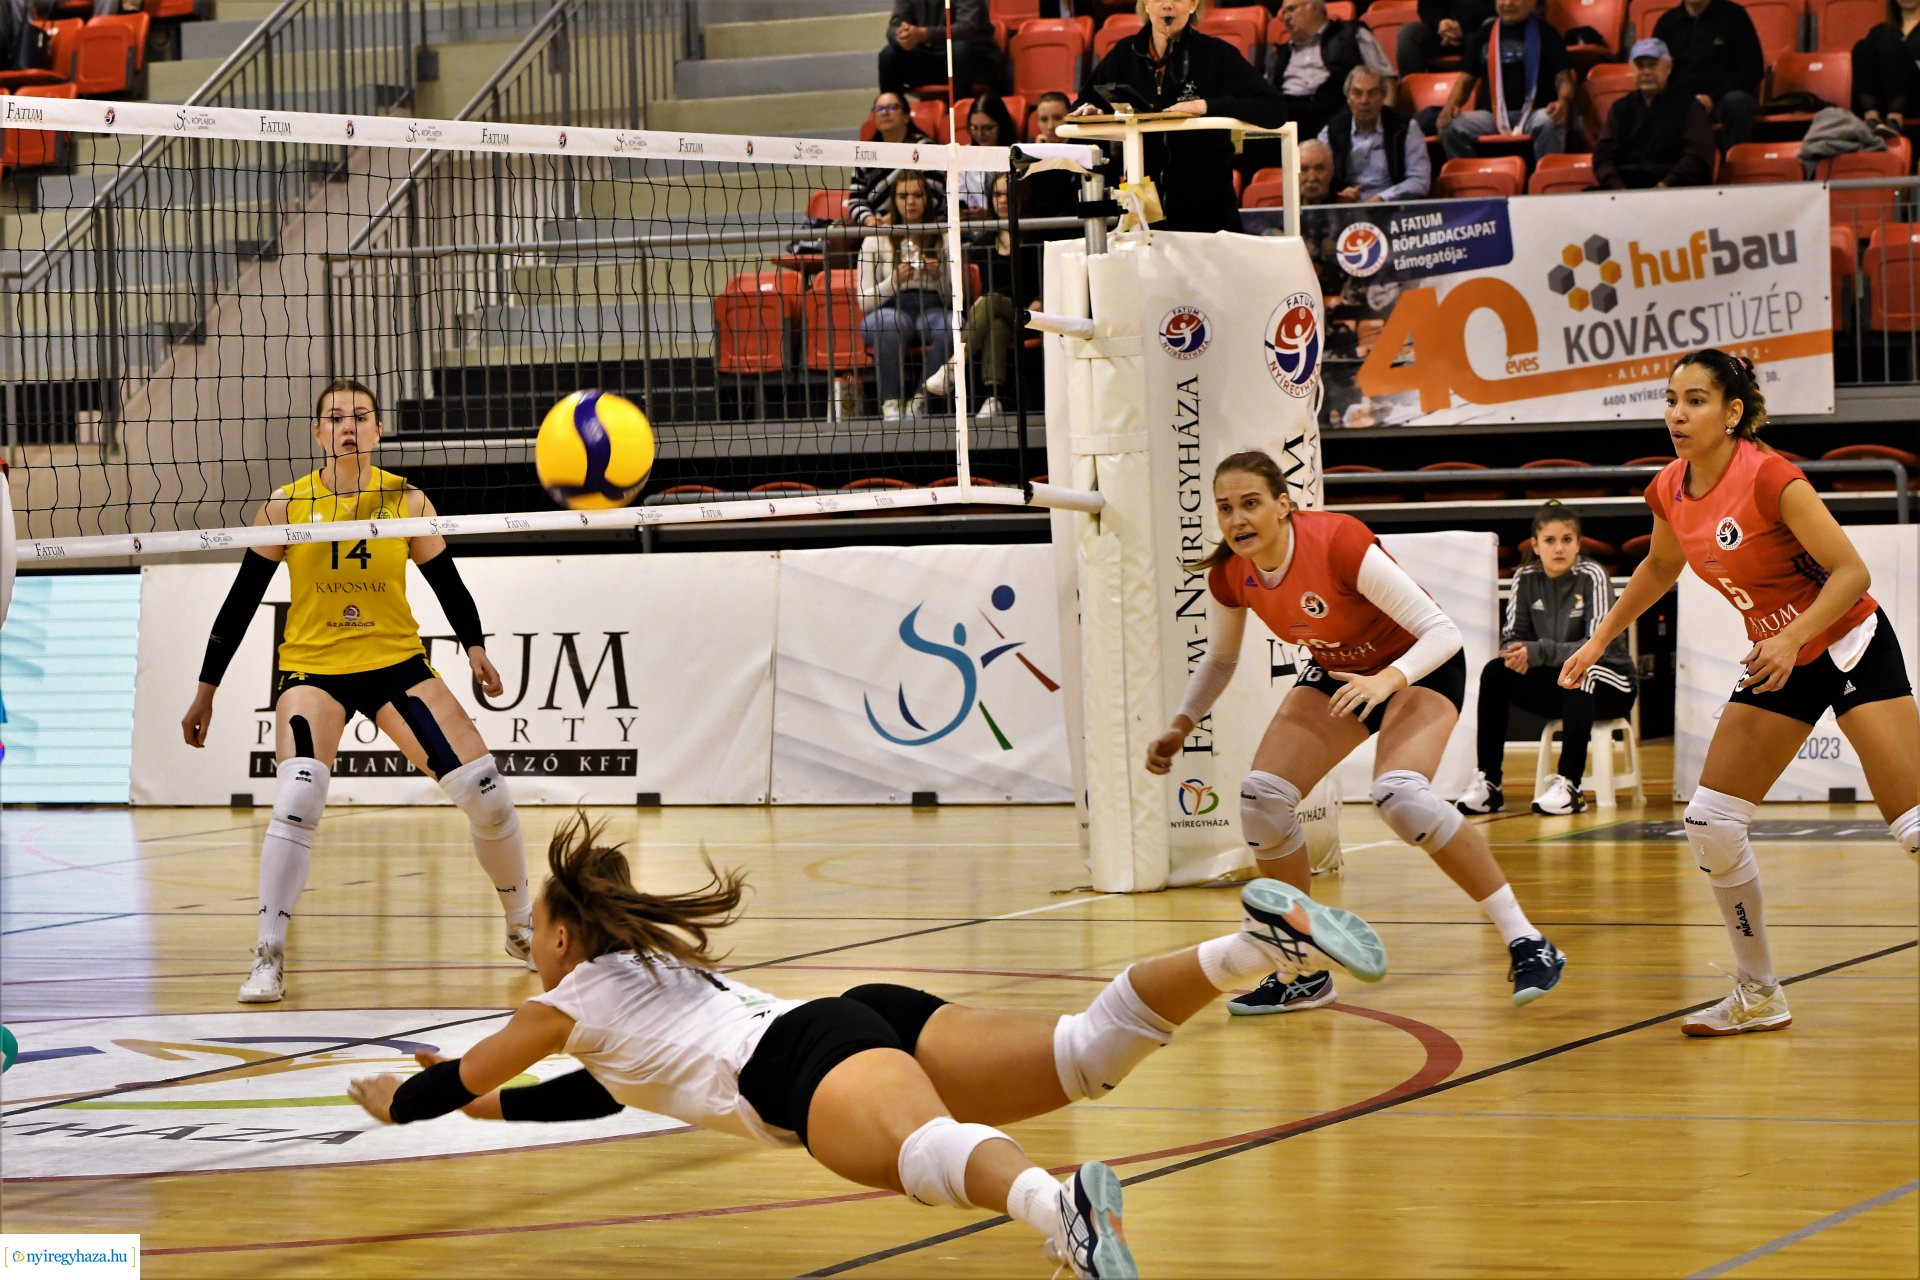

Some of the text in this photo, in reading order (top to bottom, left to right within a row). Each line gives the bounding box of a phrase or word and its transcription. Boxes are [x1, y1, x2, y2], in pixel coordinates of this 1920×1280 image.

[6, 102, 43, 120] FATUM
[260, 116, 291, 133] FATUM
[481, 128, 509, 145] FATUM
[679, 137, 704, 153] FATUM
[1390, 212, 1442, 234] A FATUM
[1392, 220, 1497, 252] RÖPLABDACSAPAT
[1394, 246, 1468, 270] támogatója:
[1628, 228, 1798, 288] hufbau
[1172, 307, 1200, 316] FATUM
[1564, 282, 1803, 365] KOVÁCSTÜZÉP
[1162, 340, 1210, 360] NYÍREGYHÁZA
[1357, 277, 1539, 414] 40
[1505, 354, 1540, 374] éves
[1618, 358, 1674, 379] ALAPÍ
[1602, 394, 1626, 406] 4400
[1629, 386, 1667, 403] NYÍREG
[285, 528, 312, 541] FATUM
[35, 543, 65, 558] FATUM
[331, 539, 372, 569] 14
[1718, 577, 1755, 610] 5
[1798, 737, 1841, 759] 2023
[579, 755, 631, 773] KFT
[1170, 819, 1230, 828] NYÍREGYHÁZA
[1737, 902, 1754, 937] MIKASA
